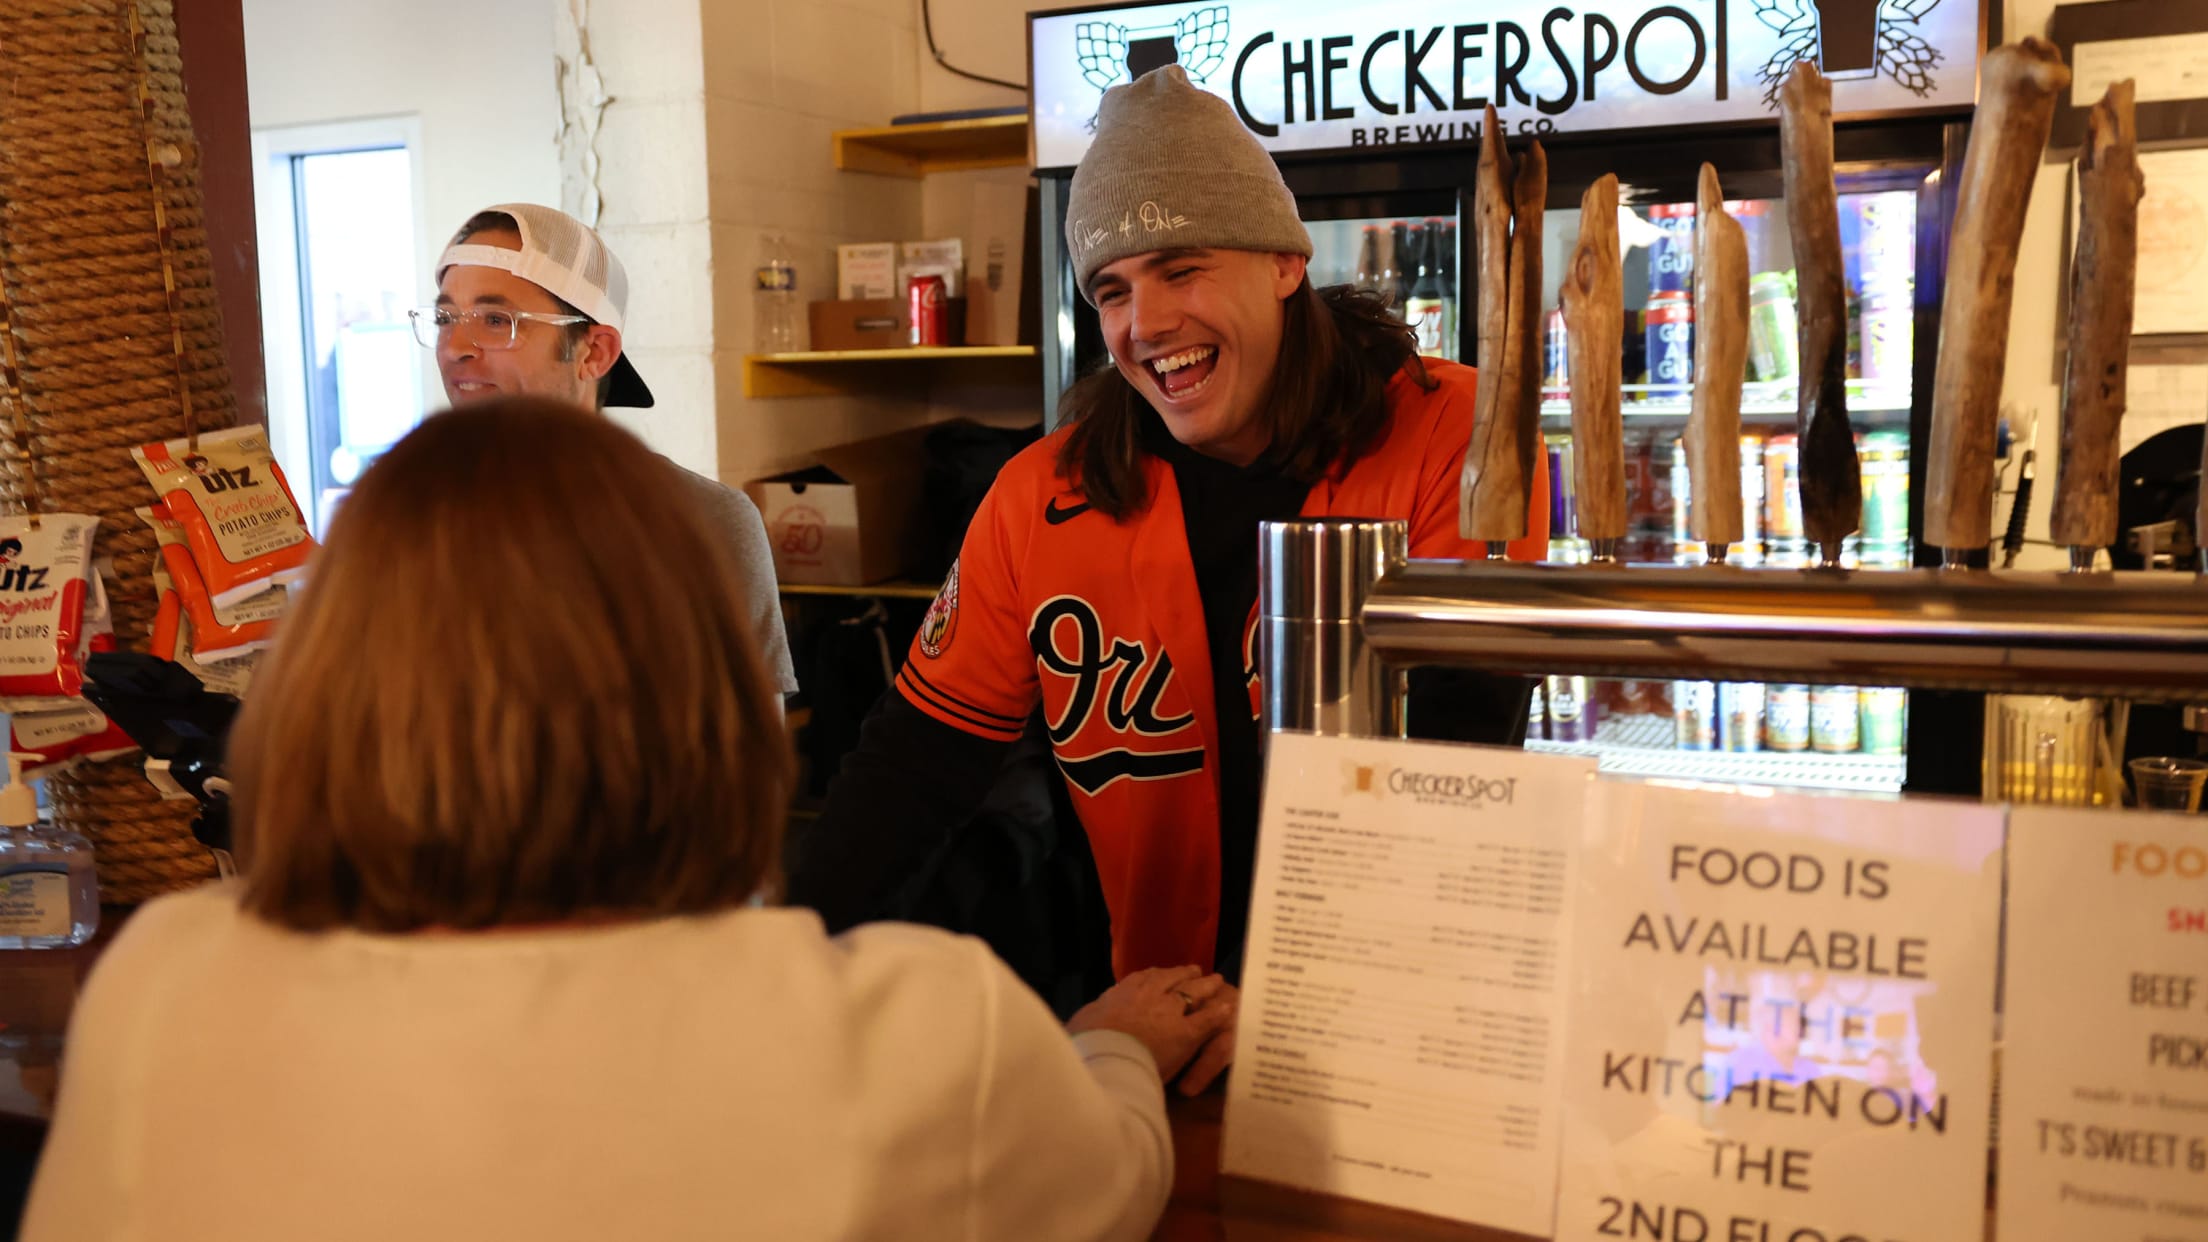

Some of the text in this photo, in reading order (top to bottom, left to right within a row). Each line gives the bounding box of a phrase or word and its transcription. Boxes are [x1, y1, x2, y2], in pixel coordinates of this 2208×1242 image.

[219, 515, 258, 537] POTATO
[261, 506, 291, 524] CHIPS
[16, 624, 49, 640] CHIPS
[1387, 768, 1518, 804] CHECKERSPOT
[1670, 845, 1890, 900] FOOD IS
[1623, 911, 1928, 979] AVAILABLE
[2129, 971, 2197, 1009] BEEF
[1678, 990, 1873, 1048] AT THE
[1603, 1052, 1948, 1135] KITCHEN ON
[1704, 1138, 1813, 1192] THE
[2037, 1118, 2077, 1156] T'S
[2083, 1124, 2178, 1168] SWEET
[1597, 1197, 1709, 1242] 2ND
